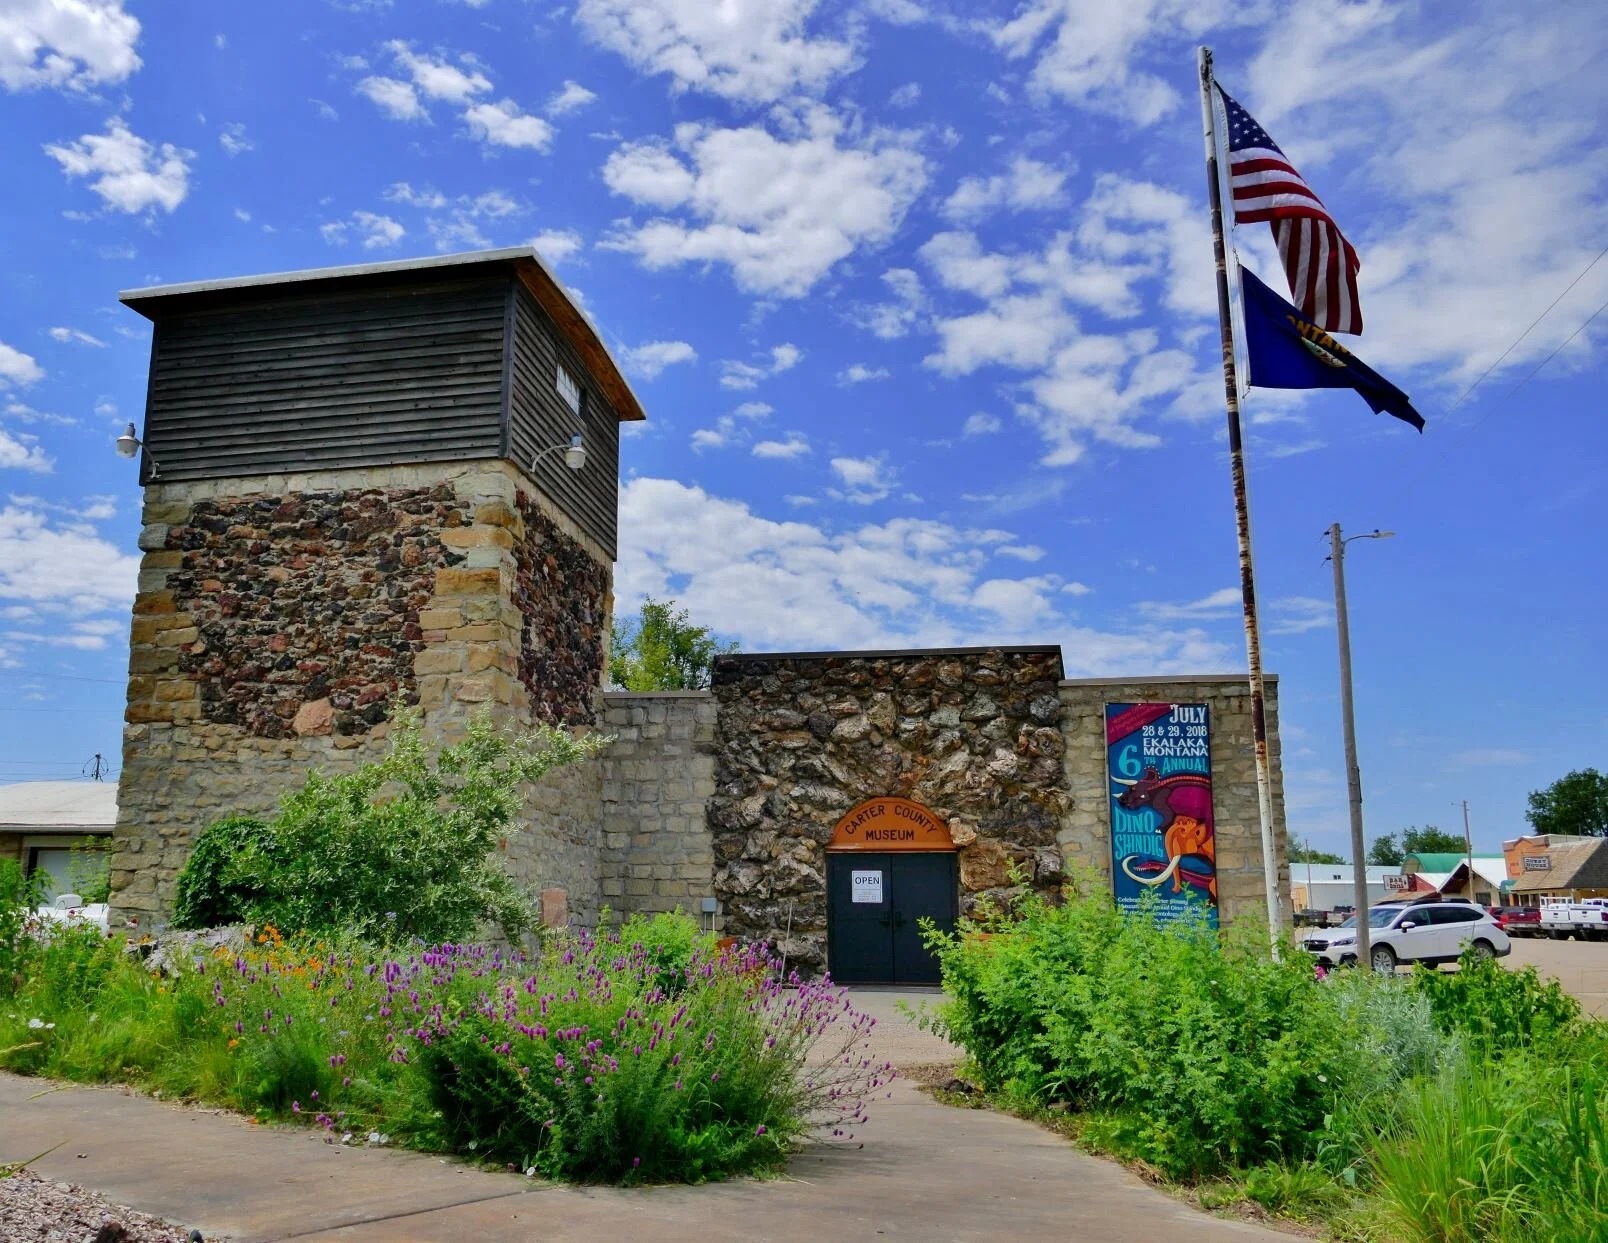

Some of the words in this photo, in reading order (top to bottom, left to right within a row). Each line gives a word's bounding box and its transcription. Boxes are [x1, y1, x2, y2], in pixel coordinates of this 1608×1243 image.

[1169, 704, 1206, 724] JULY
[1142, 725, 1155, 737] 28
[1157, 726, 1165, 737] &
[1186, 725, 1208, 737] 2018
[1143, 747, 1209, 757] MONTANA
[1162, 757, 1208, 775] ANNUAL
[845, 805, 886, 835] CARTER
[894, 805, 938, 834] COUNTY
[1114, 806, 1155, 833] DINO
[865, 829, 915, 841] MUSEUM
[1114, 834, 1164, 860] SHINDIG
[854, 876, 880, 885] OPEN
